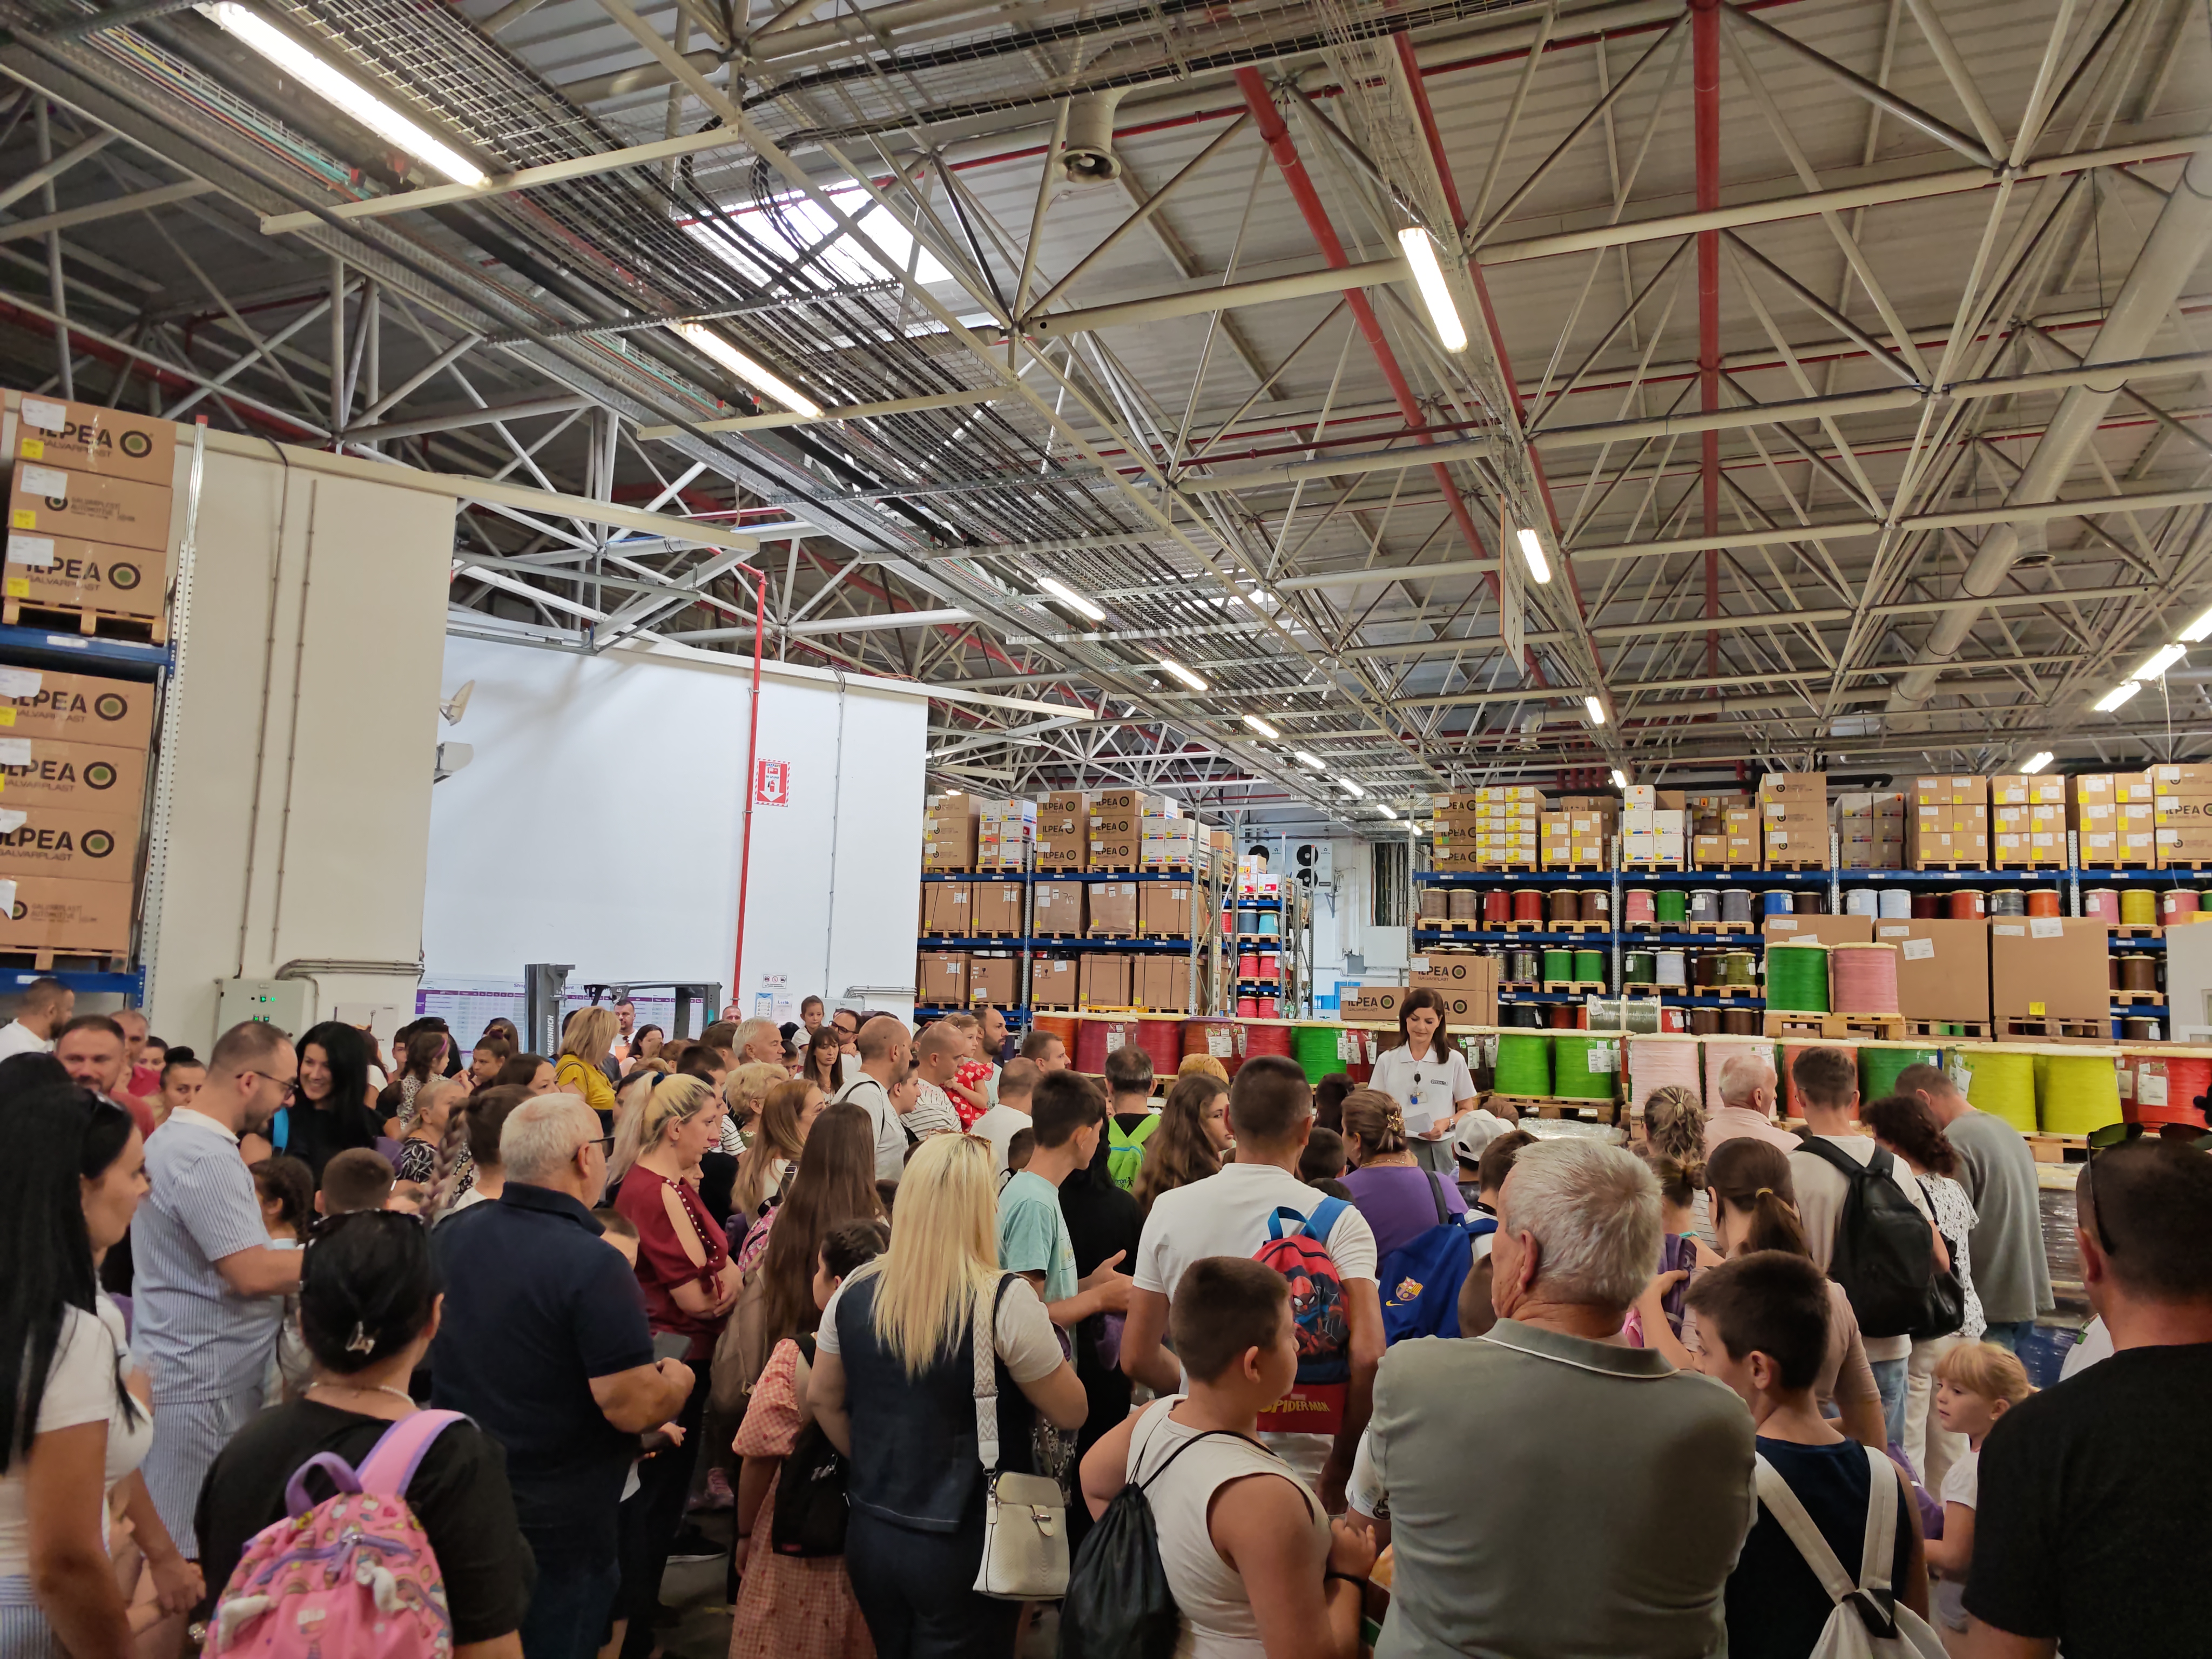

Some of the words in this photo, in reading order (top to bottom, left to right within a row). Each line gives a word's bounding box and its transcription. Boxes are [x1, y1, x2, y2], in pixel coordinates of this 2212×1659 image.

[1513, 616, 1516, 651] 2
[5, 780, 74, 792] ALVARPLAST
[1043, 851, 1064, 859] ILPEA
